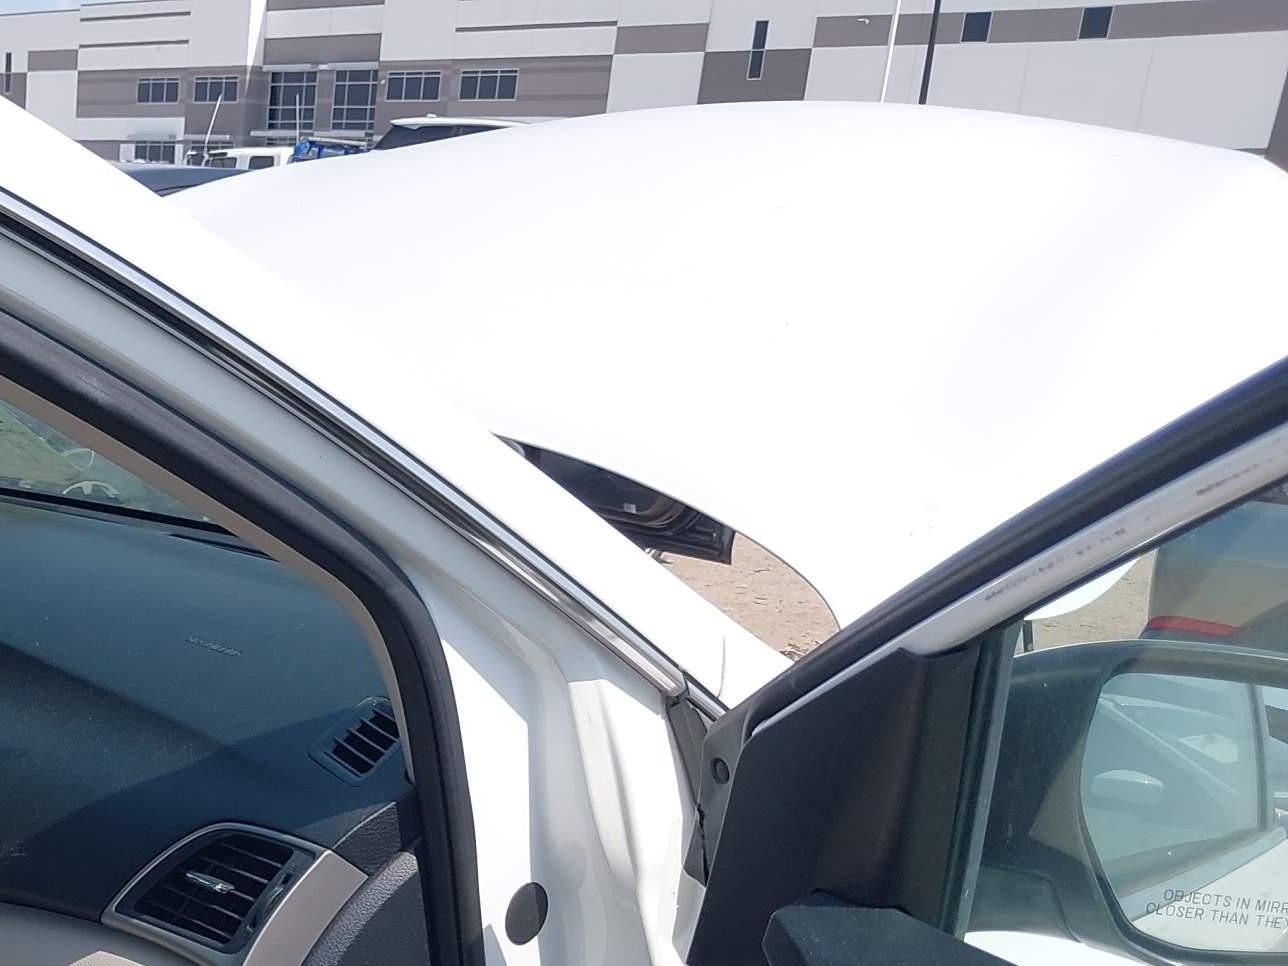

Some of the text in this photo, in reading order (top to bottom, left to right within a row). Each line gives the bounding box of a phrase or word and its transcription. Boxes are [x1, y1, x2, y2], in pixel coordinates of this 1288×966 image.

[1163, 889, 1232, 908] OBJECTS
[1236, 897, 1251, 910] IN
[1146, 902, 1204, 921] CLOSER
[1211, 909, 1249, 925] THAN
